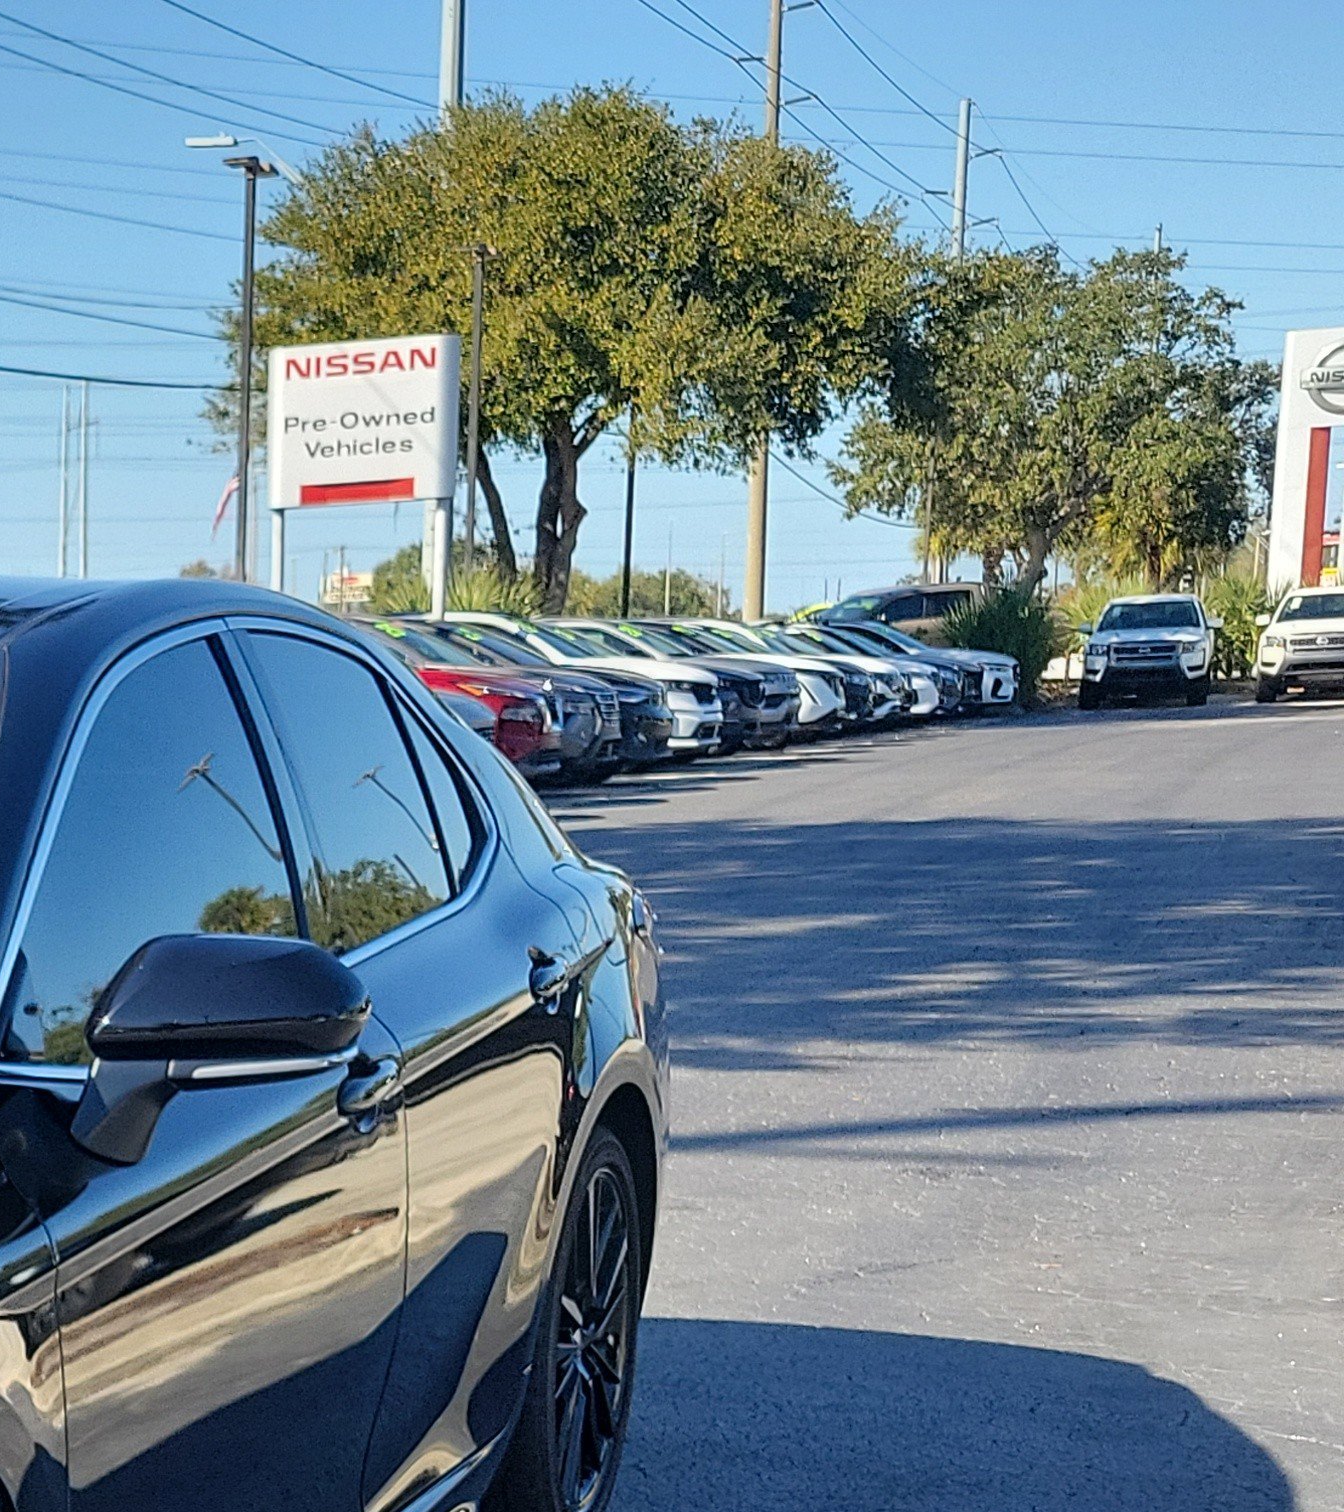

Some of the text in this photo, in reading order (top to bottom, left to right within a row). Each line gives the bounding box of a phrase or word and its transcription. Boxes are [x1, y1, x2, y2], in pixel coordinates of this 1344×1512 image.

[286, 347, 437, 380] NISSAN
[284, 406, 436, 434] Pre-Owned
[304, 436, 414, 459] Vehicles
